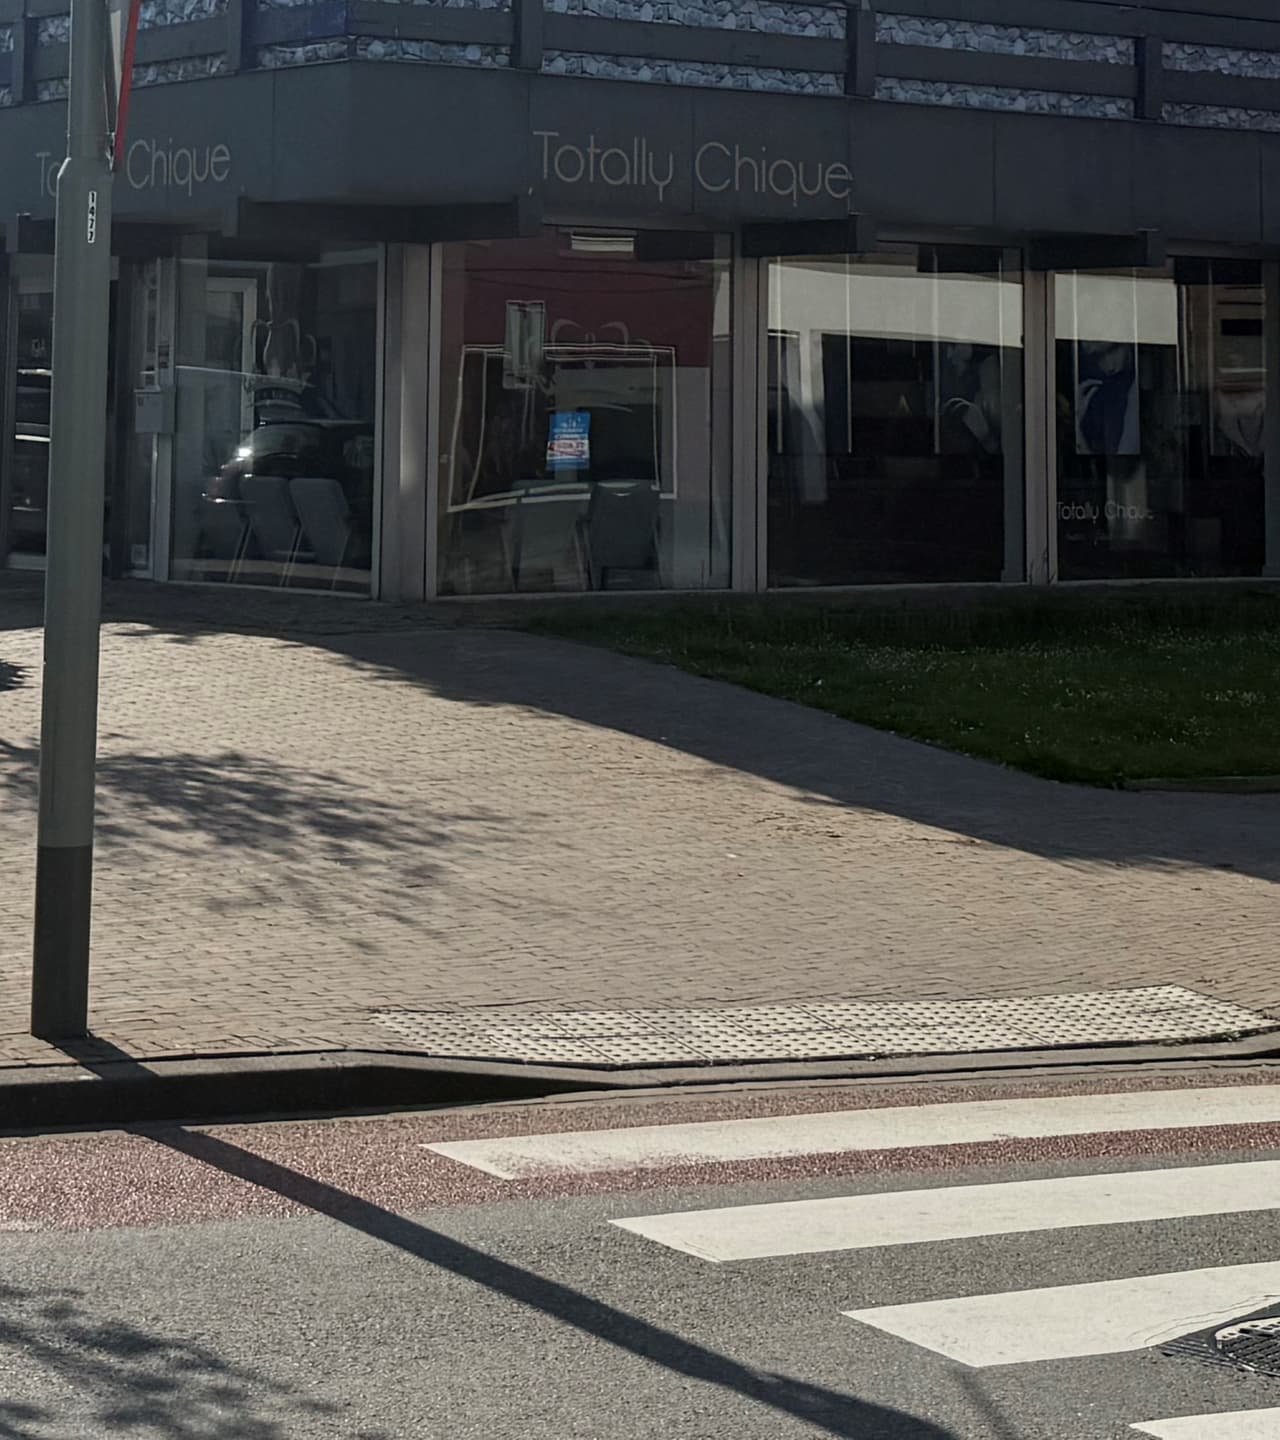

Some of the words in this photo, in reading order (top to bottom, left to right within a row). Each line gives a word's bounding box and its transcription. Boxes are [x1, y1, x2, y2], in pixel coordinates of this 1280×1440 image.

[126, 138, 230, 197] Chique
[532, 130, 673, 202] Totally
[694, 141, 852, 207] Chique
